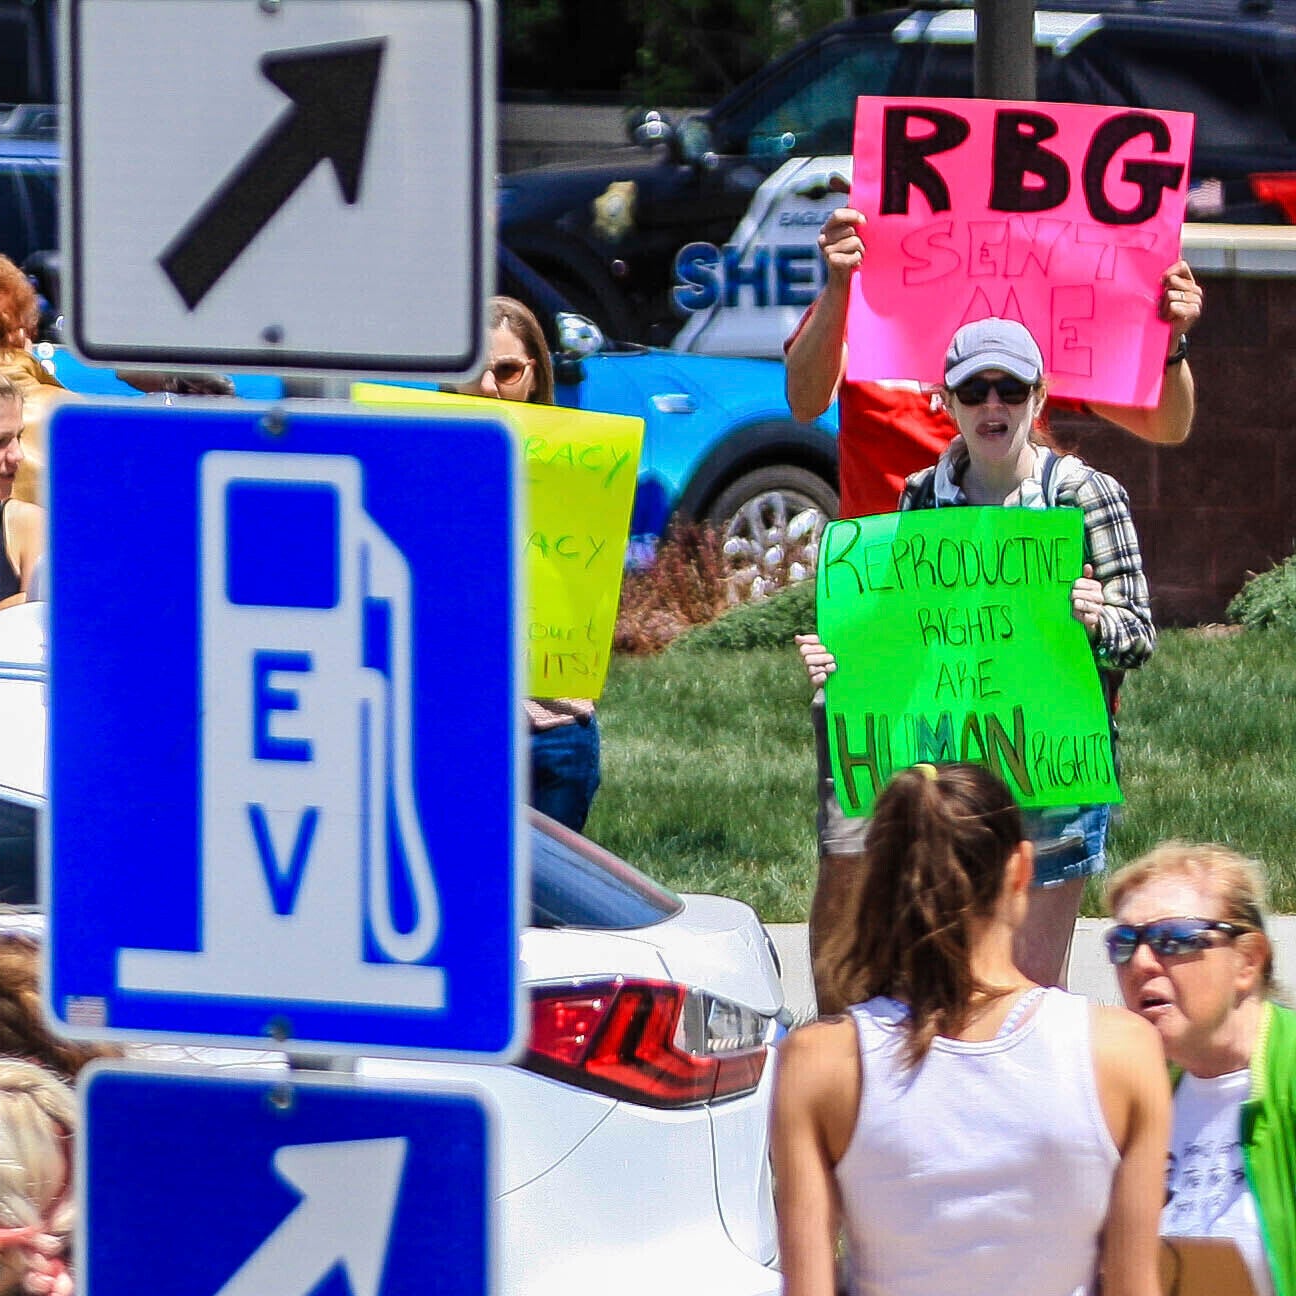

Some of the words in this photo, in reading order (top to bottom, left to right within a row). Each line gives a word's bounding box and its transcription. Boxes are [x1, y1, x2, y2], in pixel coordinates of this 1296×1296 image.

[879, 105, 1185, 226] RBG
[673, 241, 830, 312] SHE
[901, 214, 1158, 285] SENT
[523, 435, 632, 489] RACY
[524, 531, 606, 568] ACY
[824, 520, 1072, 598] REPRODUCTIVE
[527, 617, 596, 643] ourt
[917, 604, 1014, 646] RIGHTS
[935, 658, 1000, 698] ARE
[1032, 731, 1110, 790] RIGHTS
